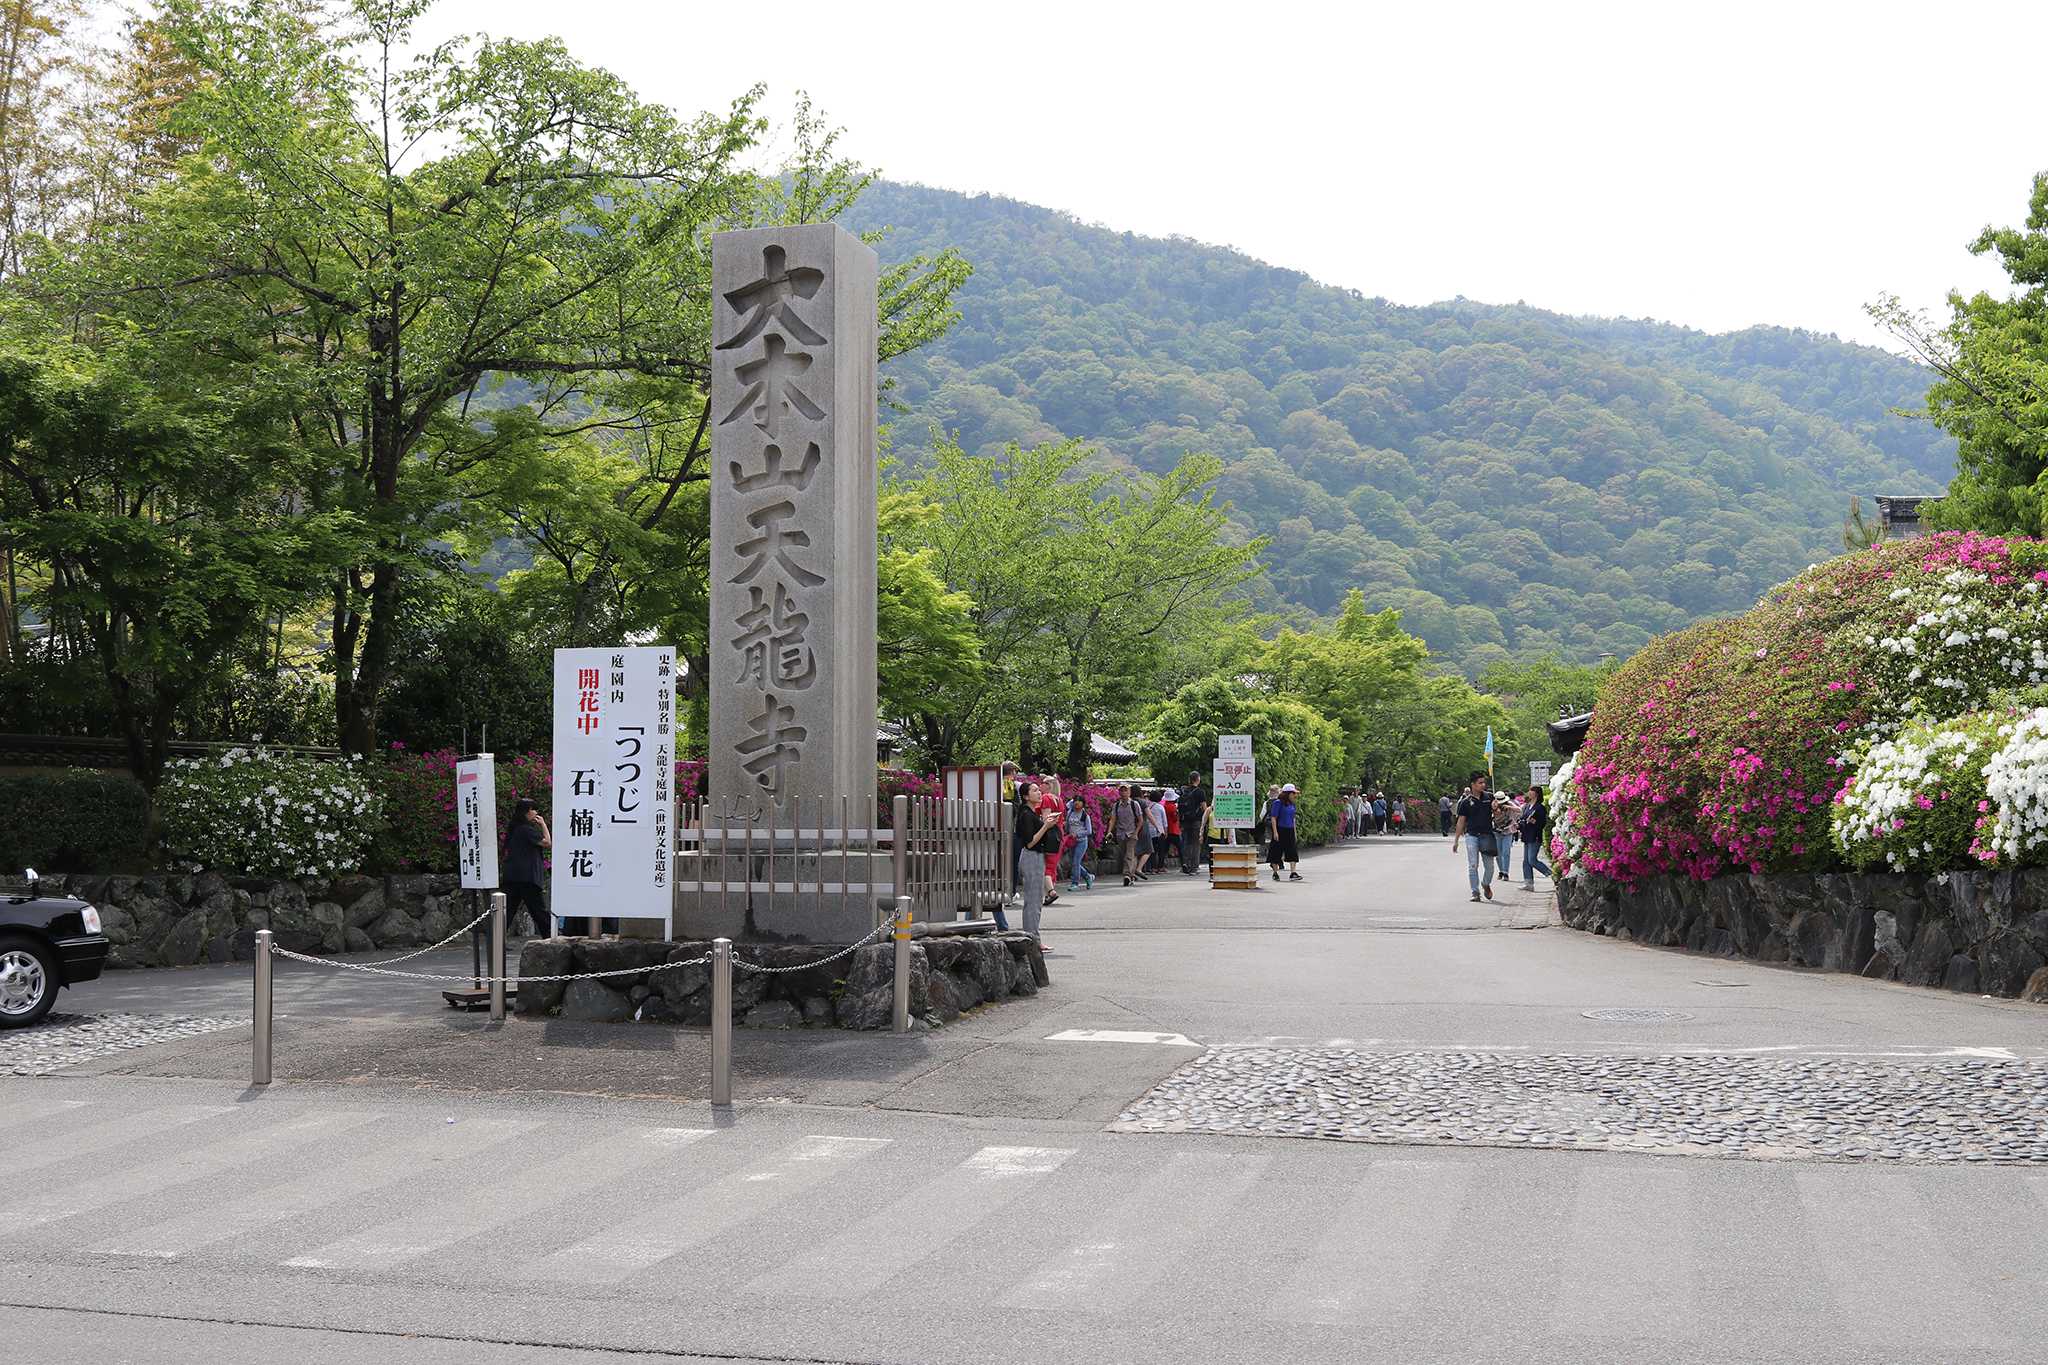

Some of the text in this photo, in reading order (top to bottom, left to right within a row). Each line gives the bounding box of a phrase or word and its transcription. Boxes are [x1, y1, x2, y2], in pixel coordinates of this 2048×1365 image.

[716, 244, 828, 806] 大本山天龍寺
[577, 668, 600, 736] 開花中
[611, 654, 625, 704] 庭園内
[657, 653, 670, 735] 史跡・特別名勝
[611, 726, 645, 824] 「つつじ」
[568, 769, 596, 878] 石楠花
